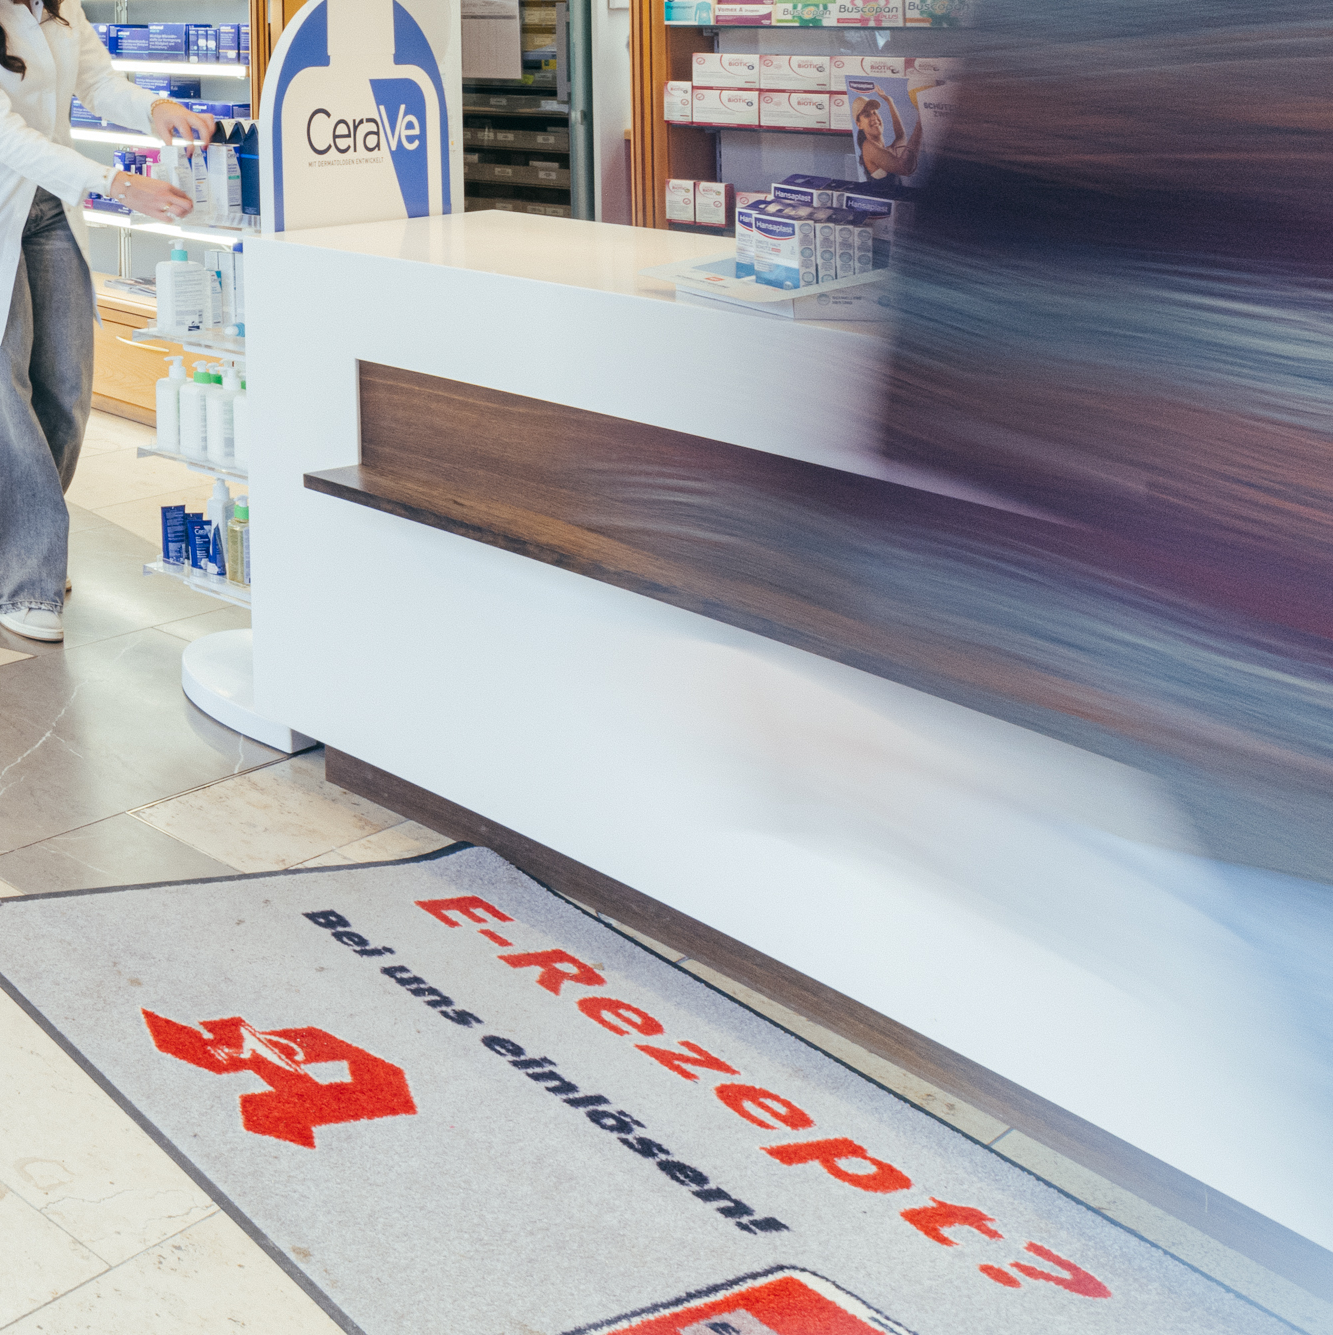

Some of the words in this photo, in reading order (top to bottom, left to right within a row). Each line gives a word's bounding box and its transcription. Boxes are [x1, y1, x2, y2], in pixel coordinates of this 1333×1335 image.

[717, 6, 737, 14] Vomex
[782, 6, 831, 17] Buscopan
[838, 4, 899, 17] Buscopan
[908, 0, 970, 12] Buscopan
[849, 81, 874, 90] Hansaplast
[306, 104, 420, 155] CeraVe
[318, 159, 355, 167] DERMATOLOGEN
[355, 157, 384, 165] ENTWICKELT
[775, 190, 812, 204] Hansaplast
[847, 200, 889, 213] Hansaplast
[756, 220, 794, 235] Hansaplast
[302, 908, 384, 961] Bei
[379, 957, 484, 1029] uns
[479, 1031, 793, 1237] einlösen!
[412, 891, 1116, 1302] E-Rezept?
